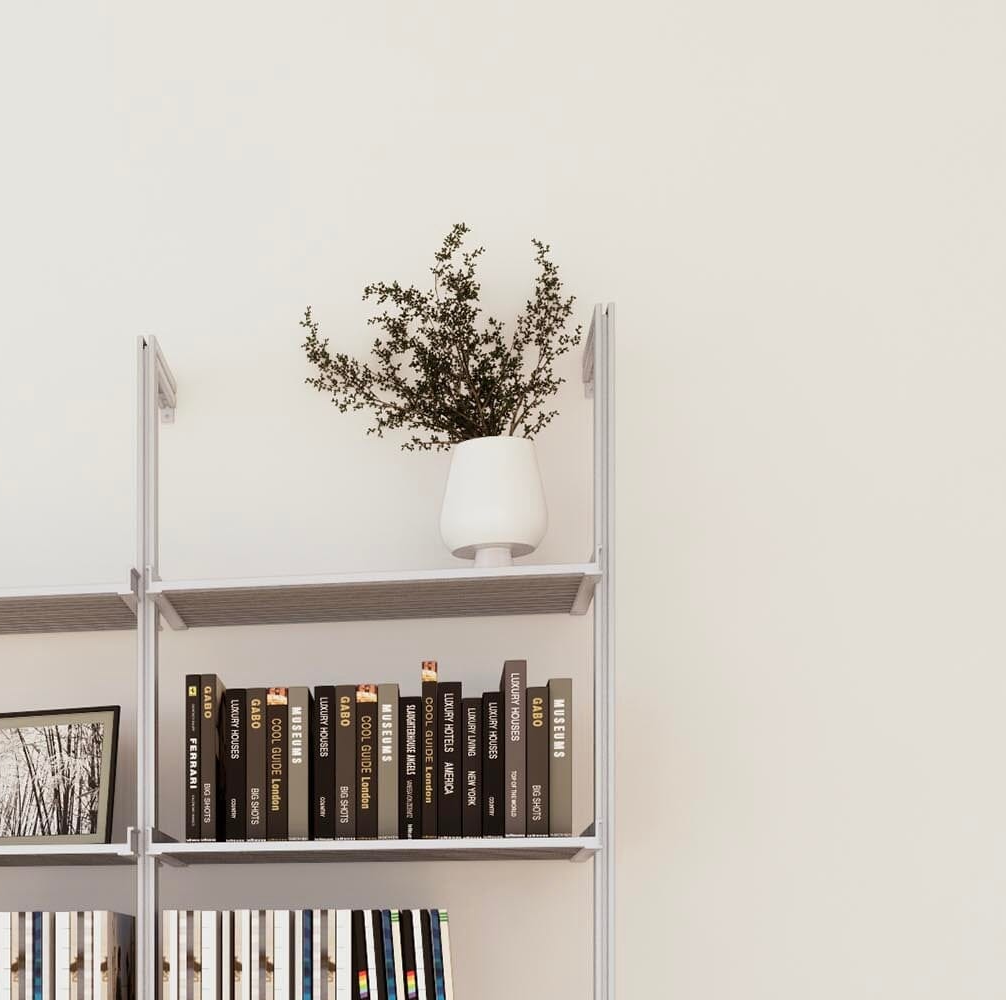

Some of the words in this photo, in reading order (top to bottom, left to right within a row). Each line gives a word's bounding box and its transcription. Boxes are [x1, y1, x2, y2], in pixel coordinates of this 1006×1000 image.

[510, 672, 520, 706] LUXURY
[230, 699, 239, 727] LUXURY
[251, 698, 261, 729] GABO
[319, 697, 329, 727] LUXURY
[340, 696, 350, 727] GABO
[425, 697, 434, 727] COOL
[444, 693, 455, 724] LUXURY
[467, 707, 477, 734] LUXURY
[488, 702, 498, 731] LUXURY
[532, 697, 543, 728] GABO
[271, 718, 282, 744] COOL
[292, 706, 302, 765] MUSEUMS
[361, 716, 372, 743] COOL
[381, 704, 392, 762] MUSEUMS
[406, 704, 416, 752] SLAUGHTERHOUSE
[444, 724, 455, 754] HOTELS
[510, 708, 520, 742] HOUSES
[553, 699, 566, 758] MUSEUMS
[230, 729, 239, 760] HOUSES
[320, 729, 329, 758] HOUSES
[425, 730, 434, 764] GUIDE
[467, 735, 477, 757] LIVING
[488, 733, 498, 760] HOUSES
[189, 738, 197, 789] FERRARI
[271, 747, 282, 775] GUIDE
[361, 745, 372, 775] GUIDE
[406, 753, 416, 776] ANGELS
[340, 786, 349, 798] BIG
[361, 778, 371, 809] London
[425, 766, 433, 804] London
[443, 761, 454, 796] AMERICA
[467, 771, 477, 788] NEW
[532, 785, 542, 797] BIG
[251, 788, 259, 800] BIG
[271, 778, 281, 811] London
[467, 788, 477, 807] YORK
[251, 801, 259, 825] SHOTS
[340, 799, 349, 824] SHOTS
[532, 798, 542, 821] SHOTS
